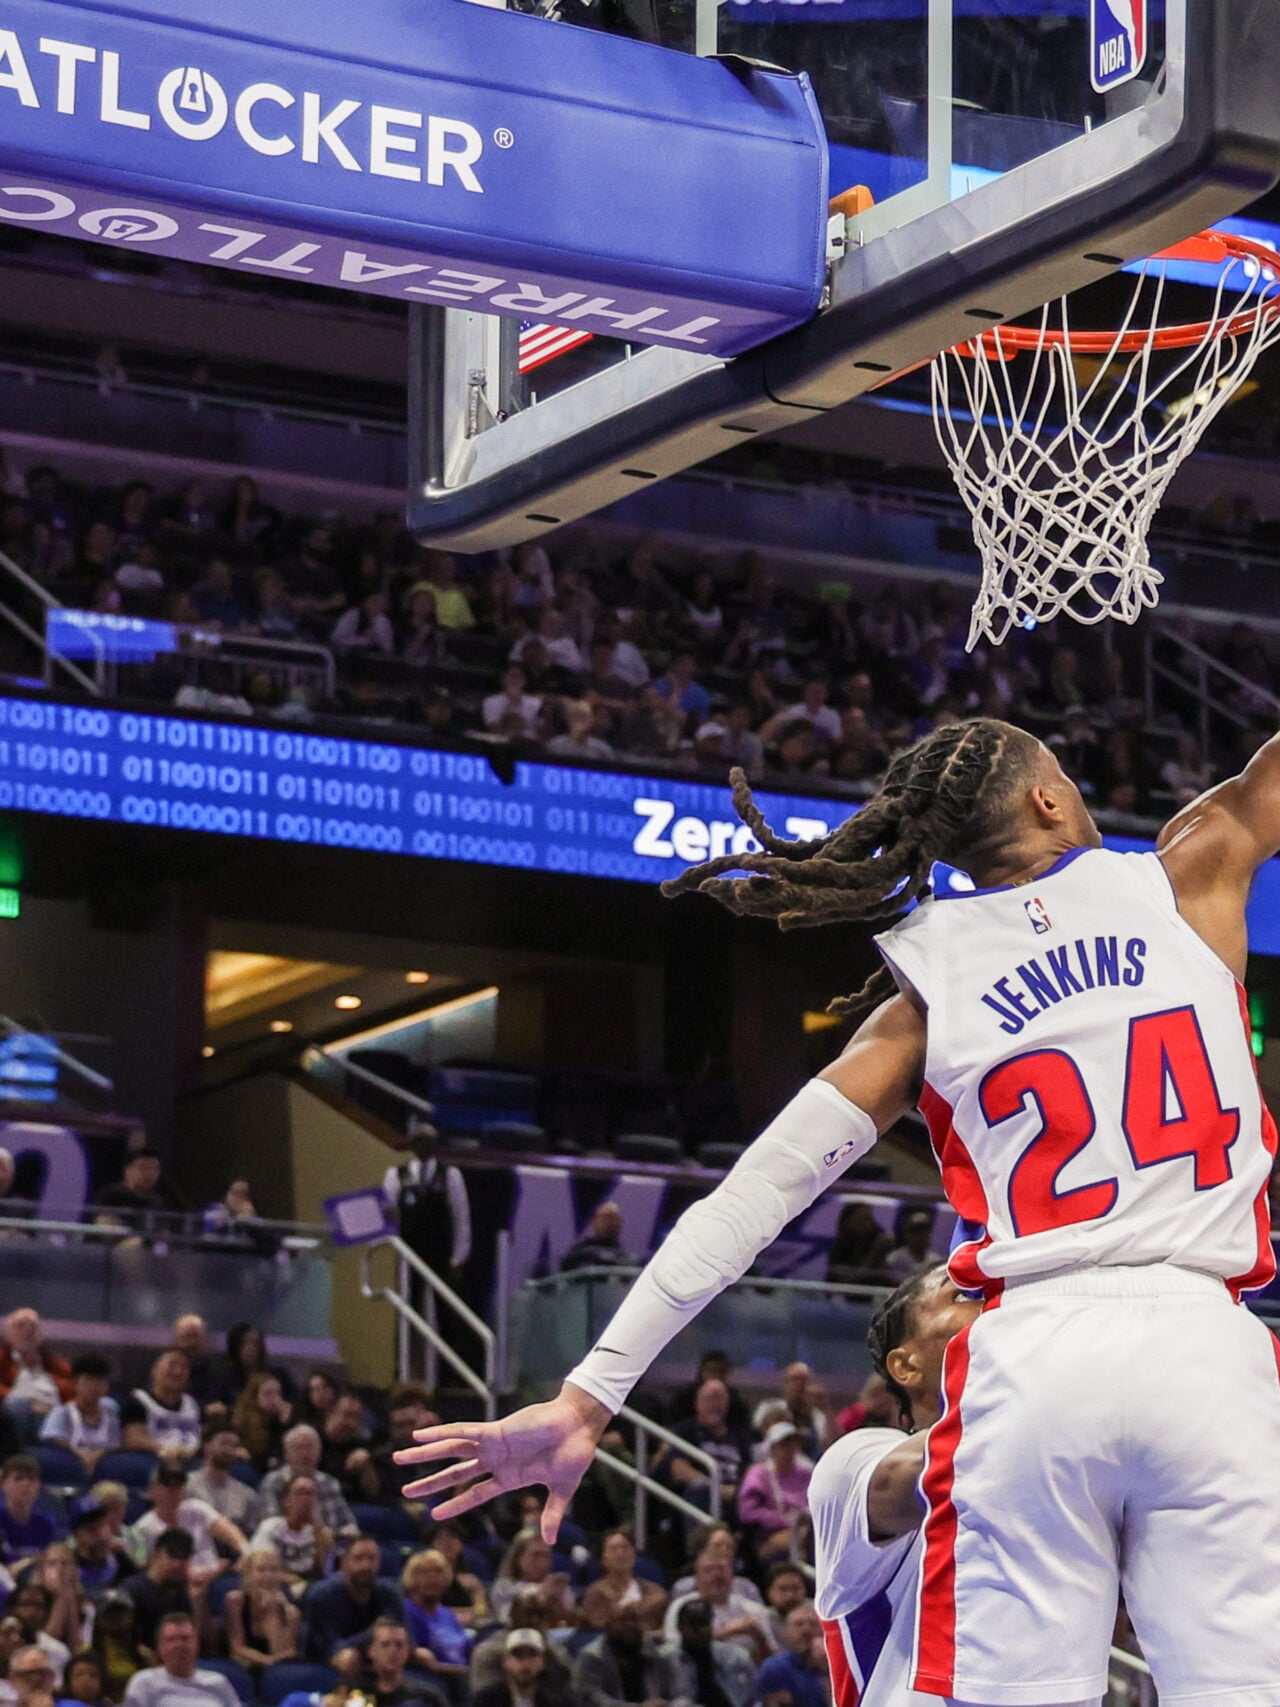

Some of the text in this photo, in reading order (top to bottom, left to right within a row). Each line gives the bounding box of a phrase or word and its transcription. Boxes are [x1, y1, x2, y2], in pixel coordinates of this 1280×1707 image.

[1100, 35, 1126, 77] NBA
[981, 936, 1146, 1035] JENKINS
[979, 1004, 1240, 1238] 24
